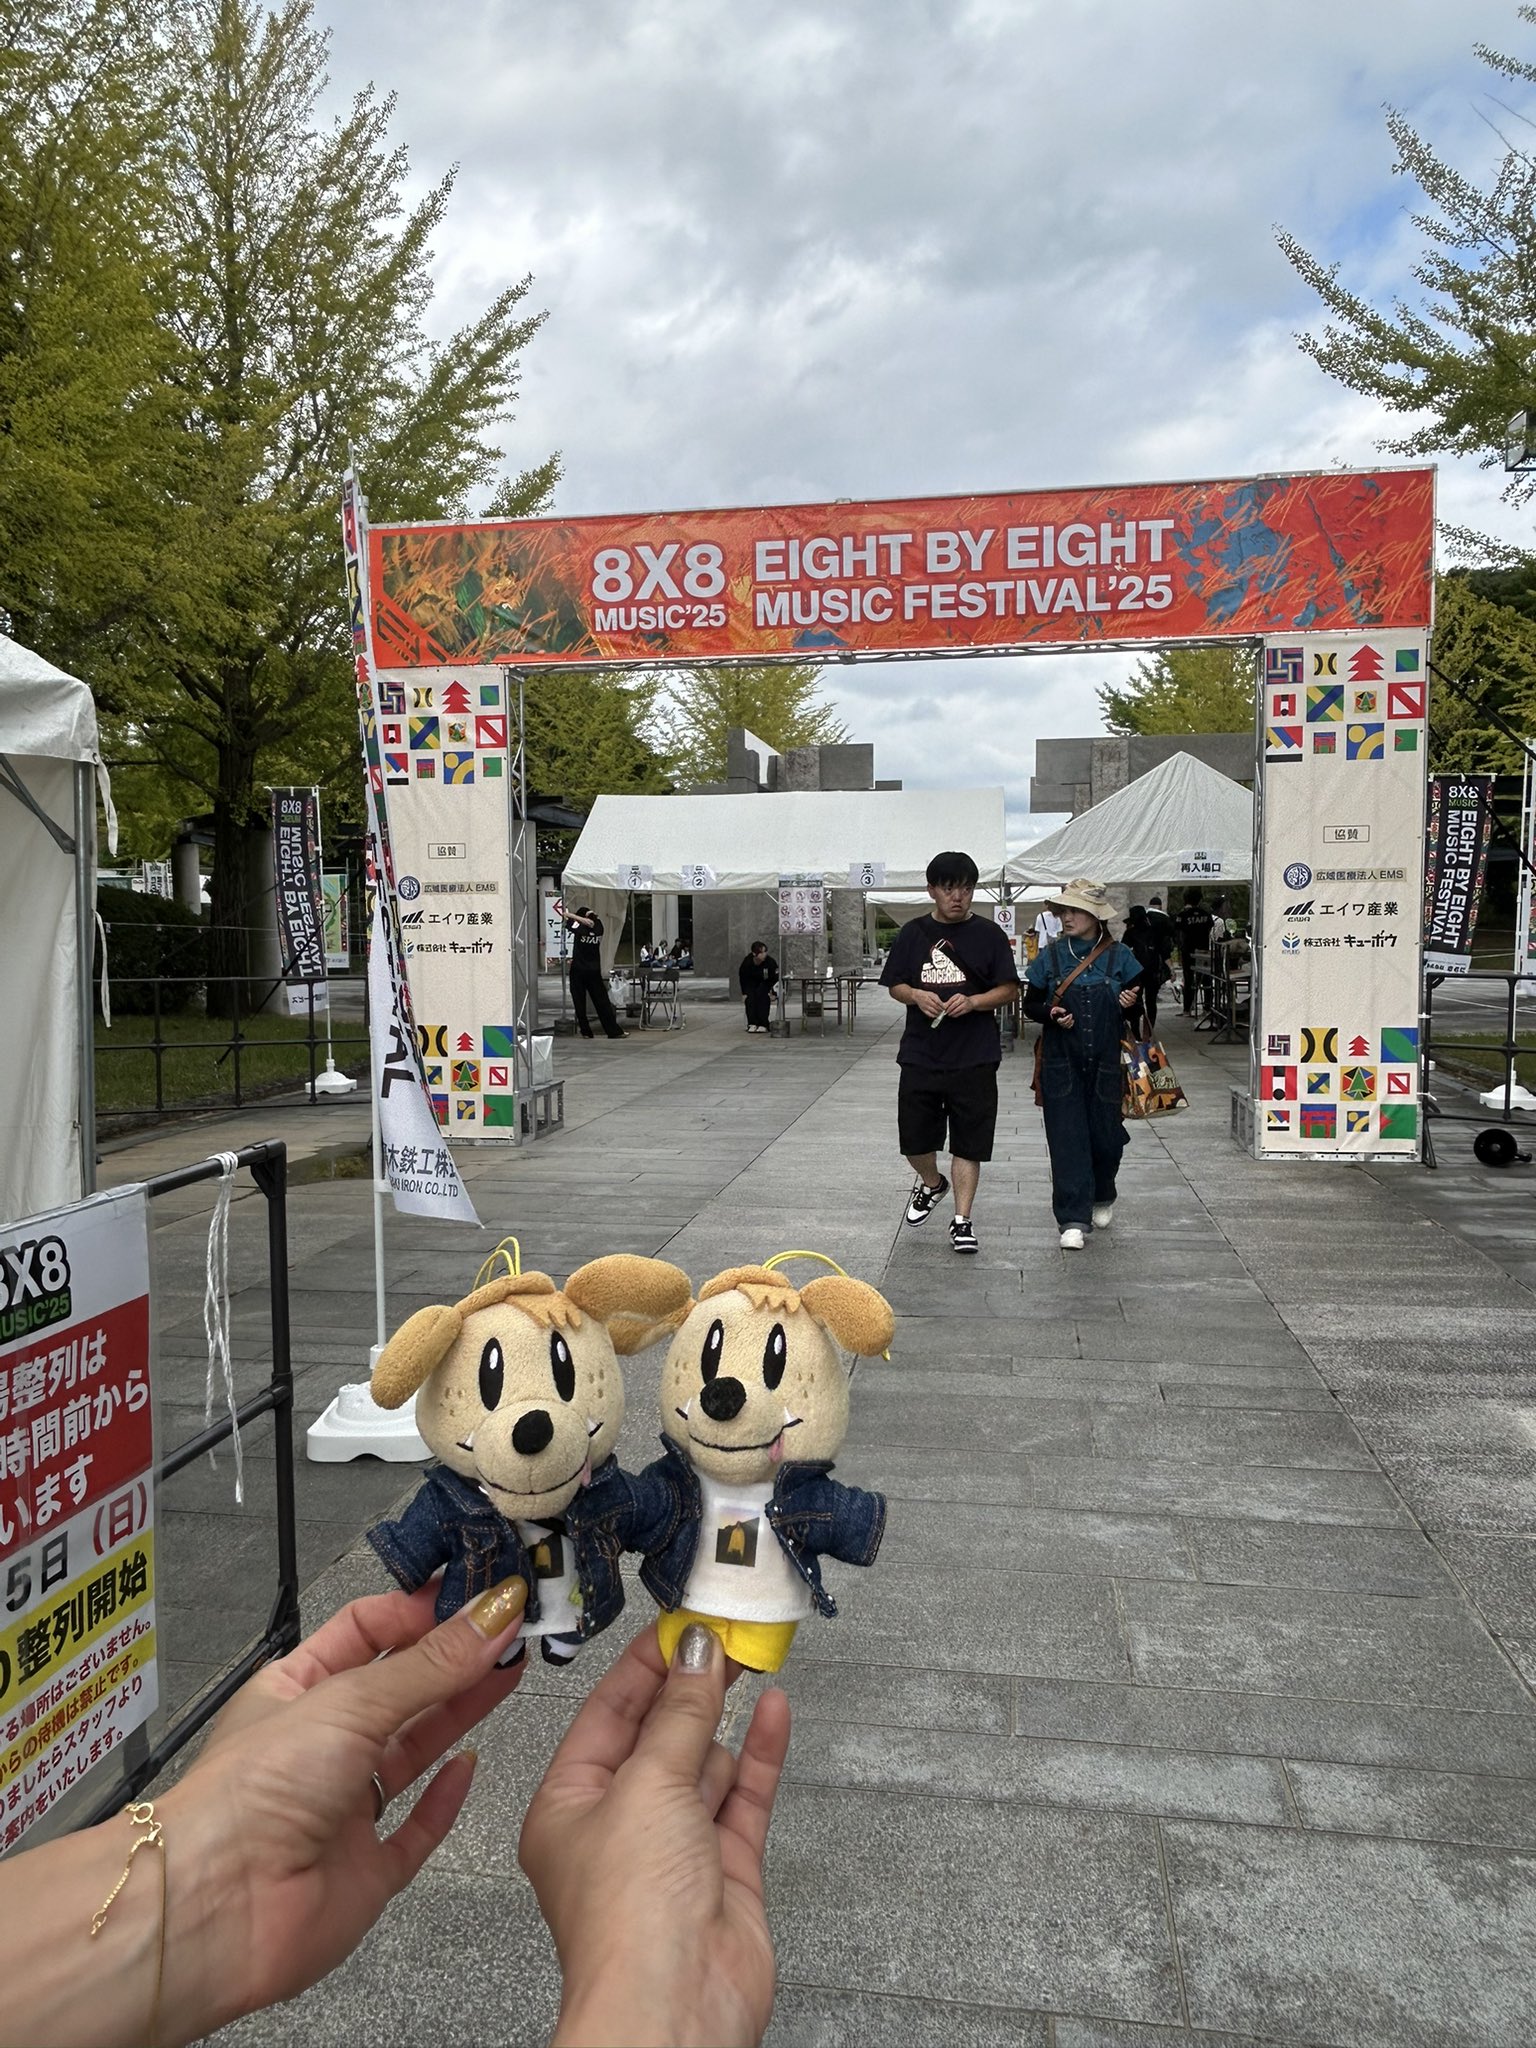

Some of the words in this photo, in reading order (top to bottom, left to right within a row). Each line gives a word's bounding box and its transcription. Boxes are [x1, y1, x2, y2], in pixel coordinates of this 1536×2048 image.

[592, 543, 726, 602] 8X8
[755, 533, 912, 582] EIGHT
[926, 529, 995, 573] BY
[1007, 519, 1174, 569] EIGHT
[595, 603, 726, 632] MUSIC'25
[756, 586, 893, 626] MUSIC
[904, 574, 1173, 620] FESTIVAL'25
[1448, 785, 1479, 798] 8X8
[1444, 810, 1461, 865] MUSIC
[1458, 810, 1477, 865] EIGHT
[1379, 870, 1403, 879] EMS
[1454, 868, 1471, 892] BY
[428, 911, 493, 925] エイワ産業
[1320, 902, 1399, 916] エイワ産業
[1429, 868, 1456, 944] FESTIVAL
[1443, 894, 1467, 949] EIGHT
[0, 1293, 70, 1338] USIC'25
[0, 1618, 151, 1742] る場所はございません。
[0, 1726, 123, 1851] 案内をいたします。
